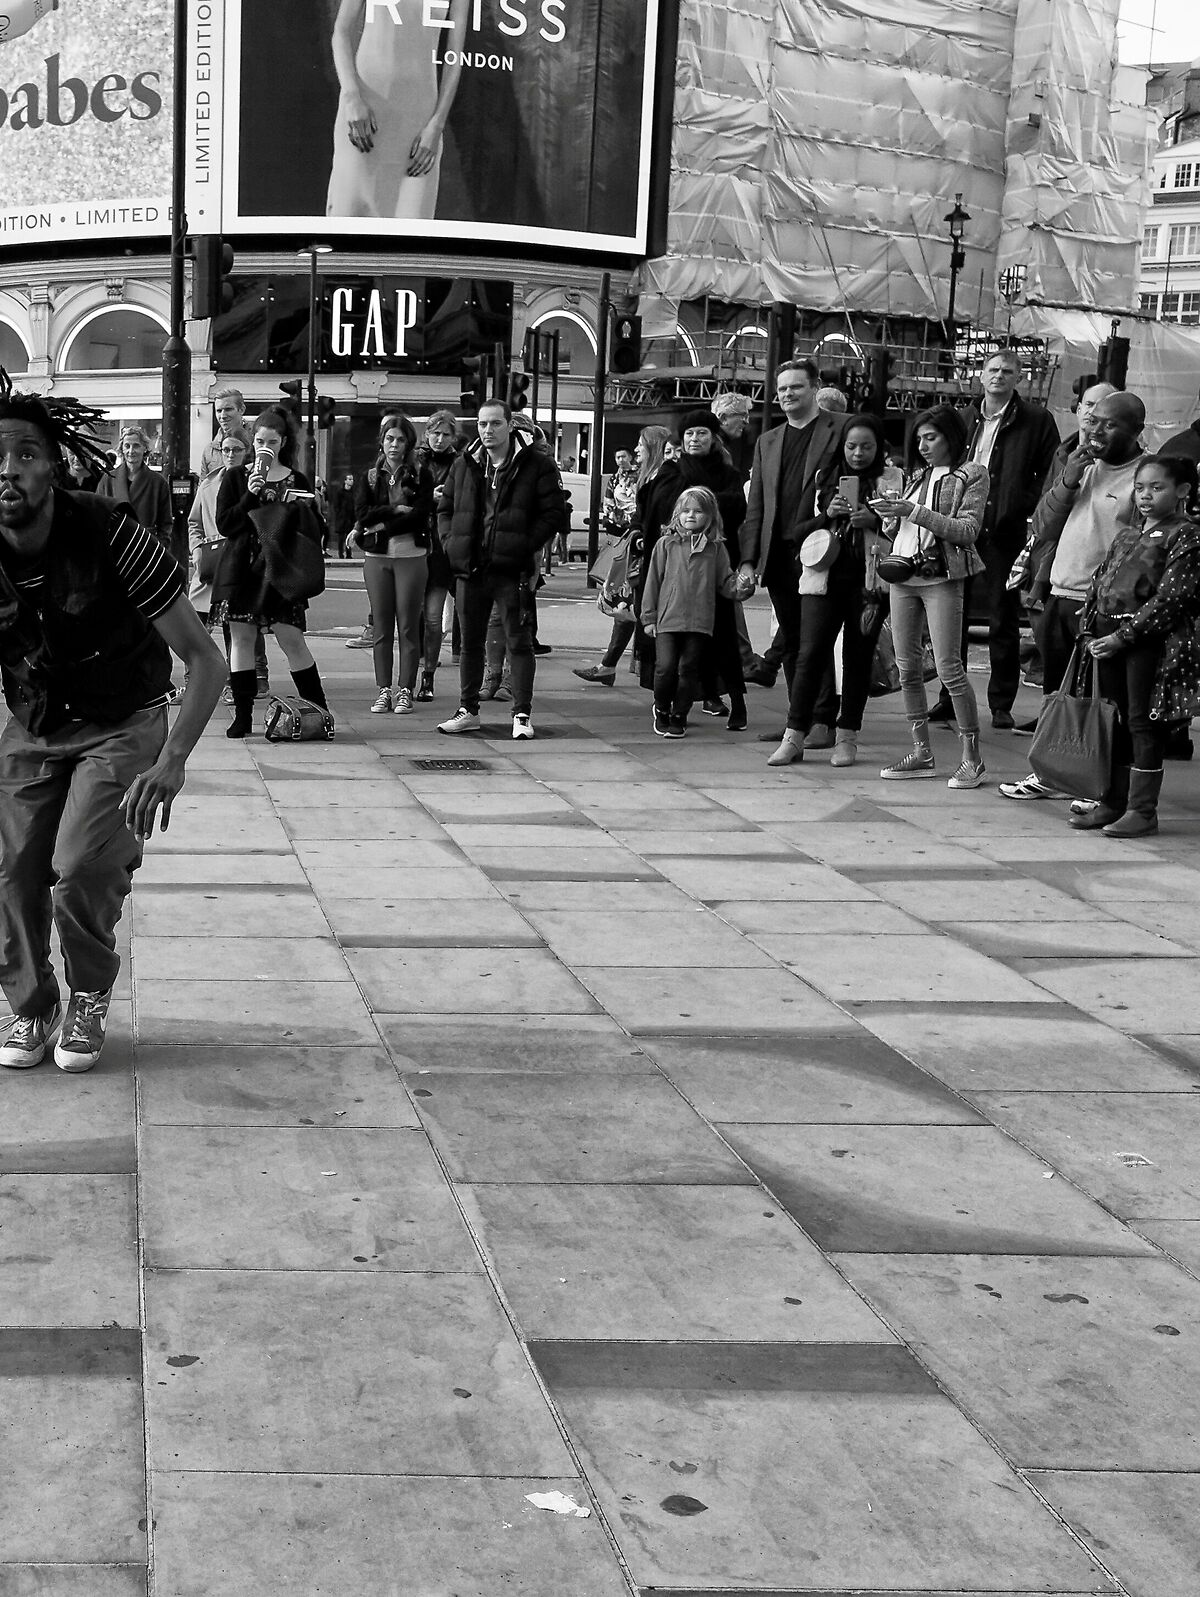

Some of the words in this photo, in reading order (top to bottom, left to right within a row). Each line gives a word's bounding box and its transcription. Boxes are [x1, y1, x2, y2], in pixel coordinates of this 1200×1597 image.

[196, 0, 212, 81] EDITIO
[365, 0, 567, 43] REISS
[431, 49, 514, 72] LONDON
[195, 91, 210, 184] LIMITED
[75, 207, 158, 226] LIMITED
[331, 287, 418, 357] GAP
